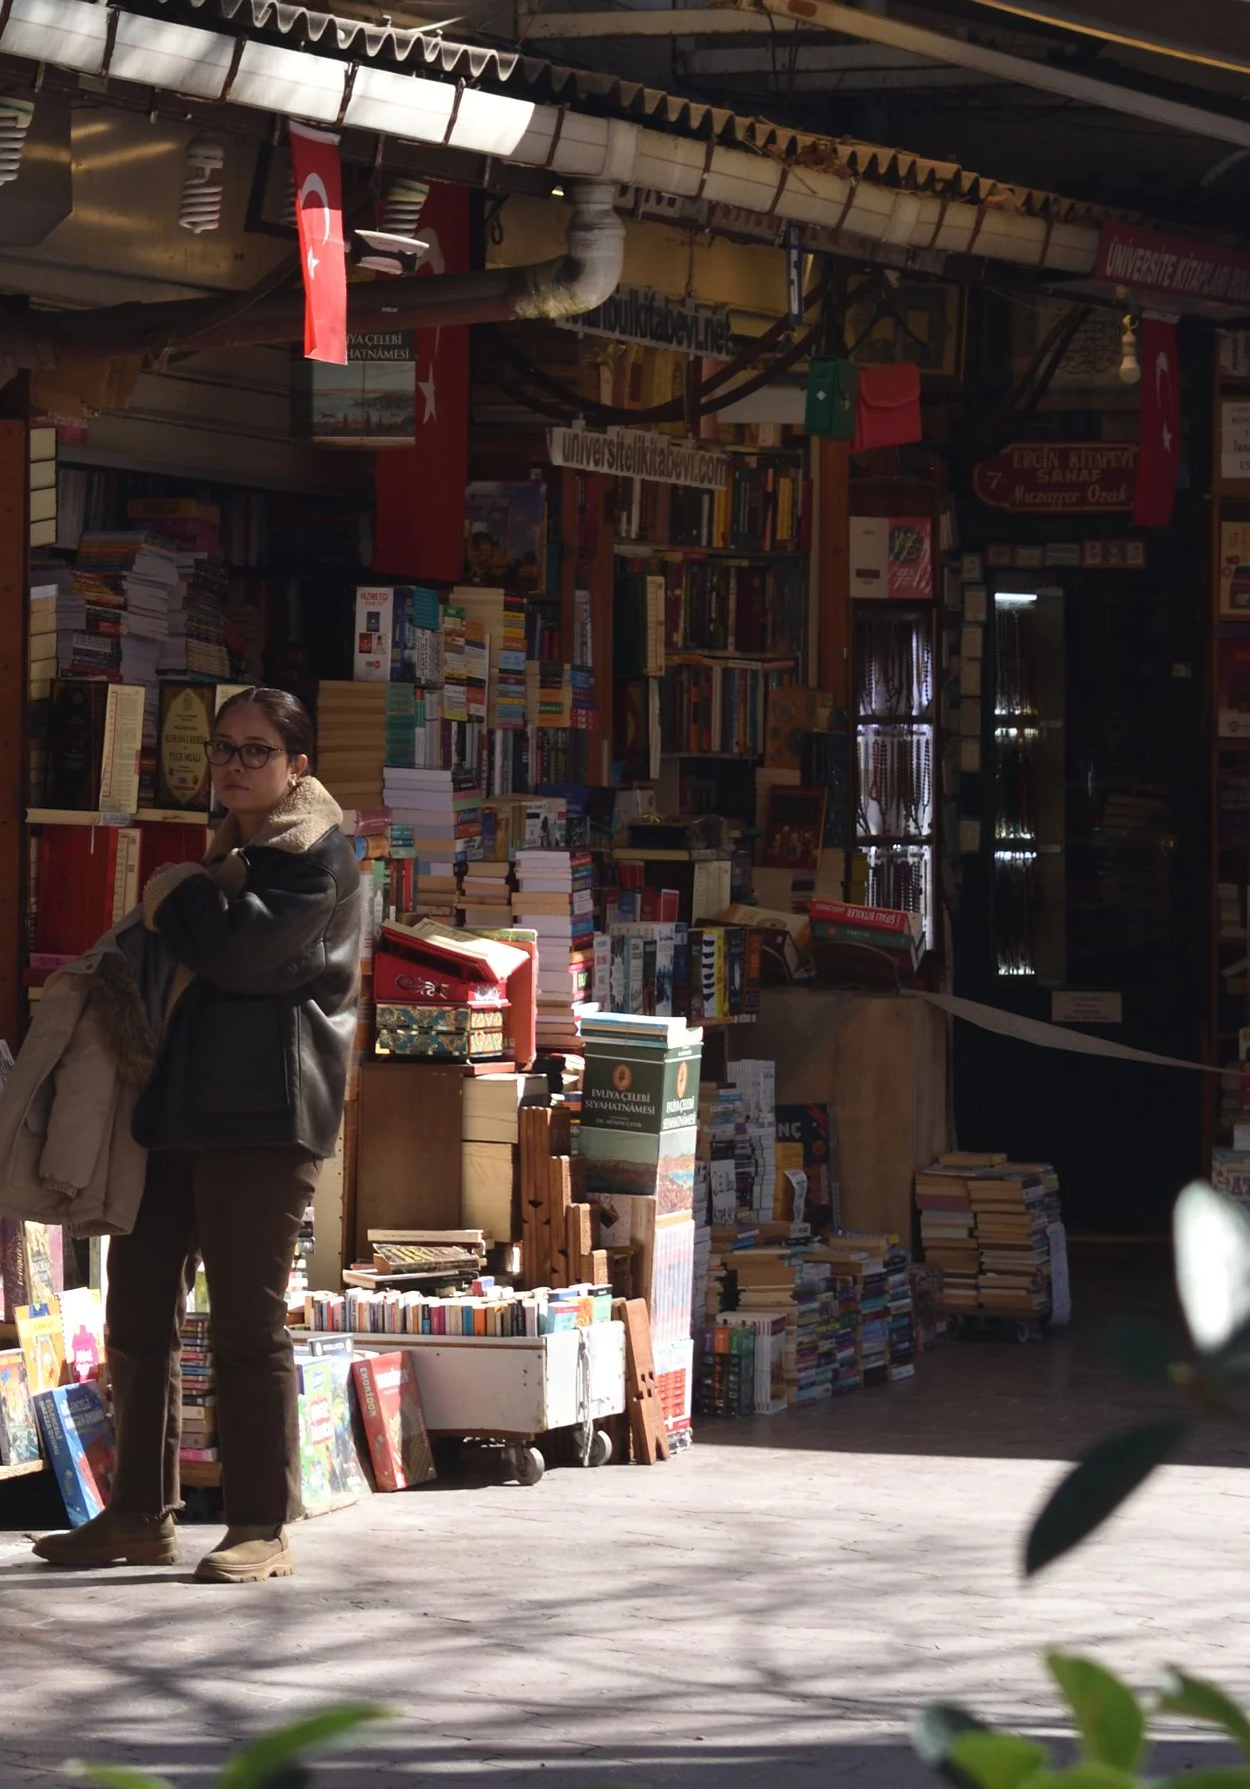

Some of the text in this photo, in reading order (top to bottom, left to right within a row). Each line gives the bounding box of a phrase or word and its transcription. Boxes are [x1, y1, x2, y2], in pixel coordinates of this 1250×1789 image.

[1106, 235, 1177, 288] ÜNİVERSİTE
[365, 333, 402, 347] ÇELEBİ
[1037, 468, 1101, 484] SAHAF
[592, 1088, 650, 1104] EVLİYA ÇELEBİ
[585, 1099, 655, 1115] SEYAHATNÂMESİ
